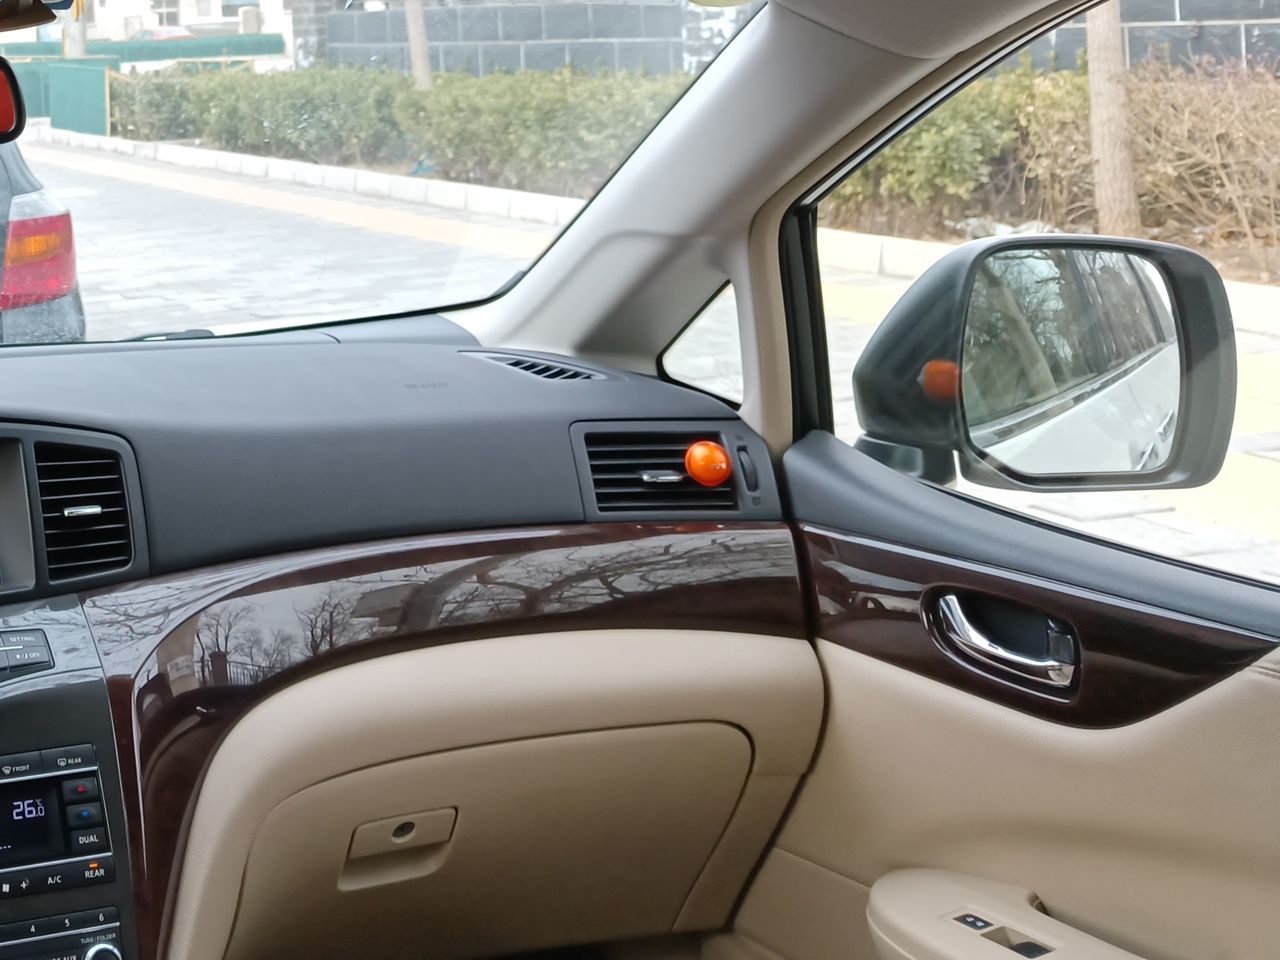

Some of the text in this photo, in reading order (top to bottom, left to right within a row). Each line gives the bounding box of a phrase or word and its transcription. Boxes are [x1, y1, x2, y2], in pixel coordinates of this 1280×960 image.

[78, 834, 99, 844] DUAL
[84, 868, 105, 878] REAR
[47, 875, 62, 885] A/C
[99, 913, 104, 921] 6
[64, 919, 70, 927] 5
[30, 925, 35, 933] 4
